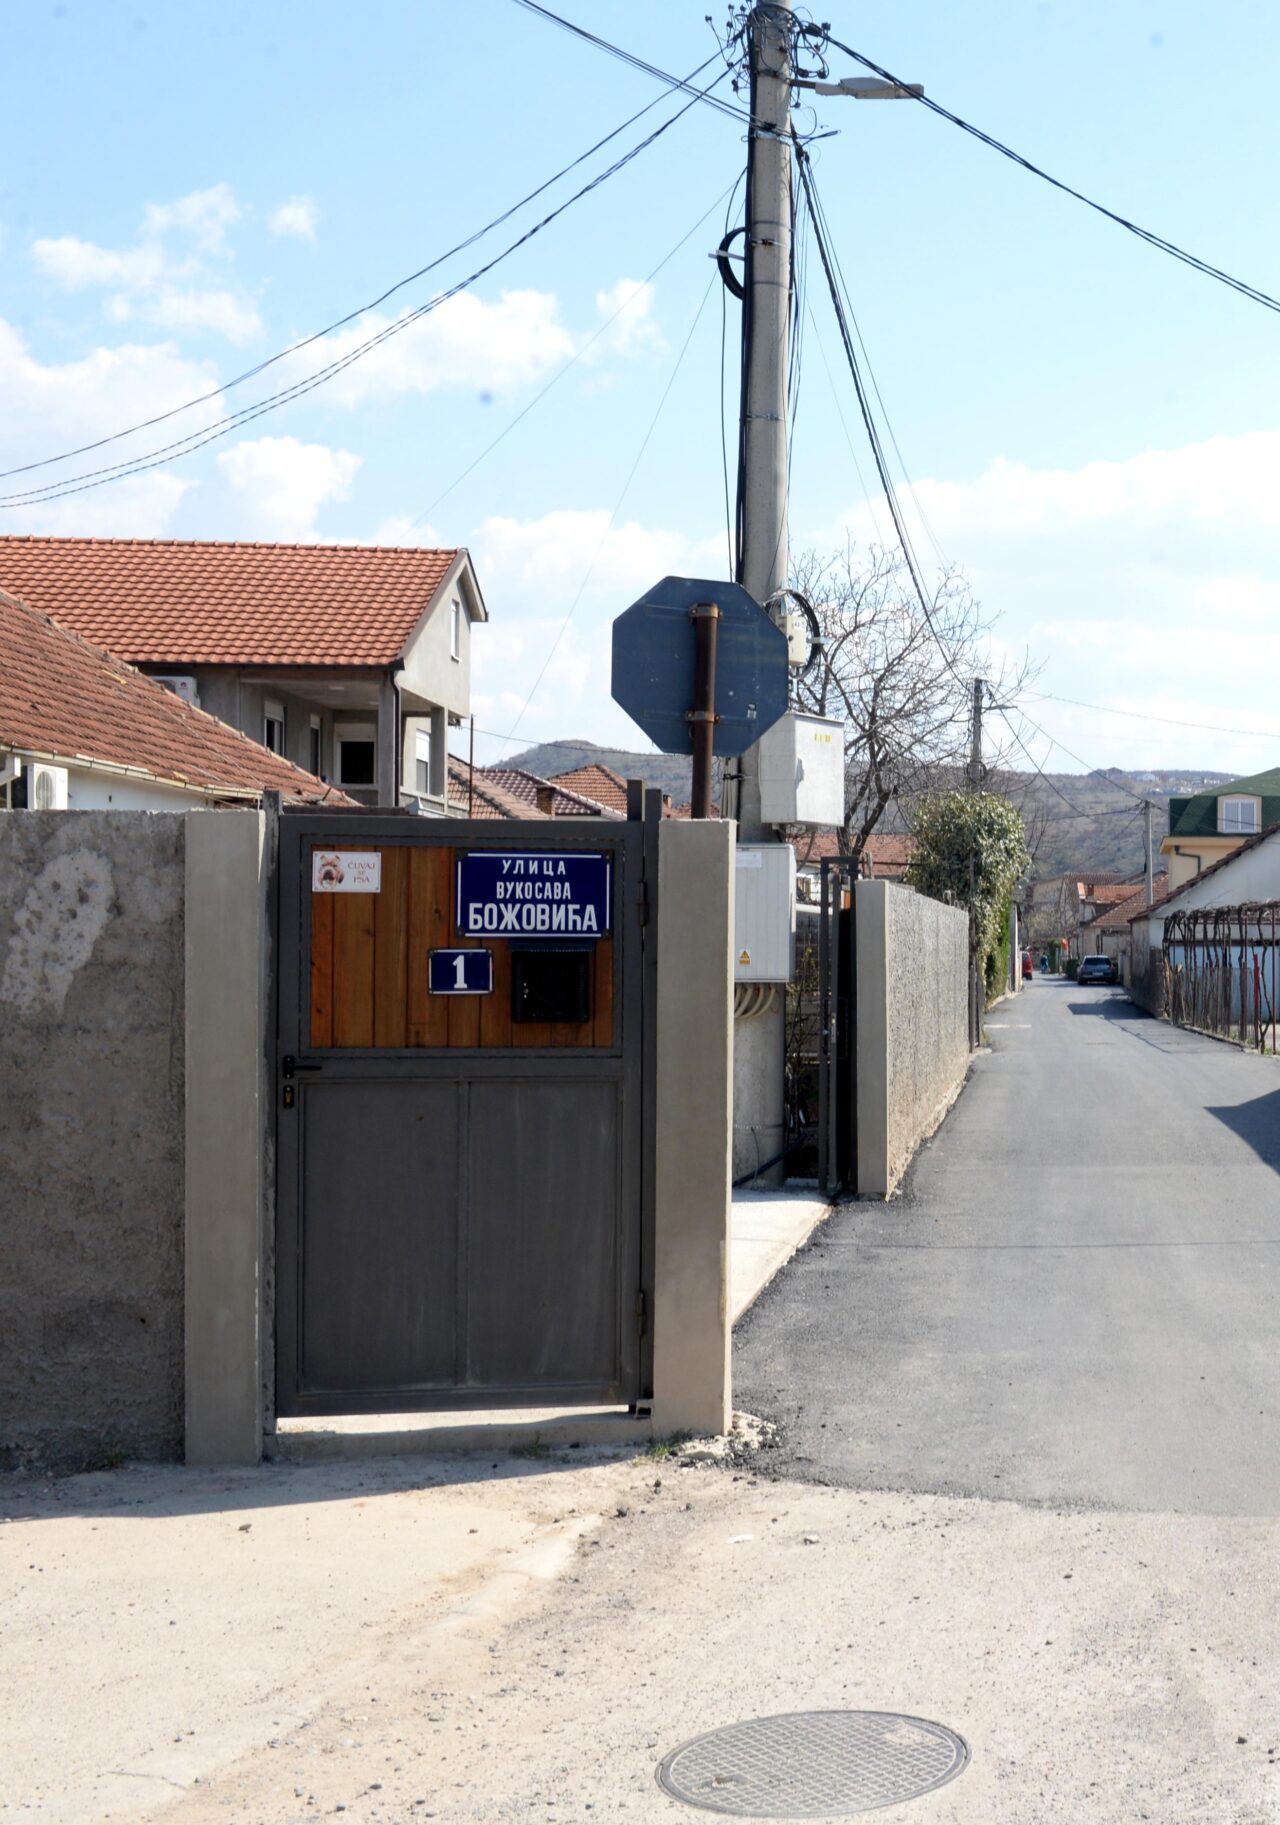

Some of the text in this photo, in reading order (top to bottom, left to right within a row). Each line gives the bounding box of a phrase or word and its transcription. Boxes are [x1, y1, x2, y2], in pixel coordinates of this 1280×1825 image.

[502, 859, 566, 876] УЛИЦА
[496, 881, 572, 900] ВУКОСАВА
[469, 902, 599, 931] БОЖОВИЋА
[452, 954, 468, 989] 1
